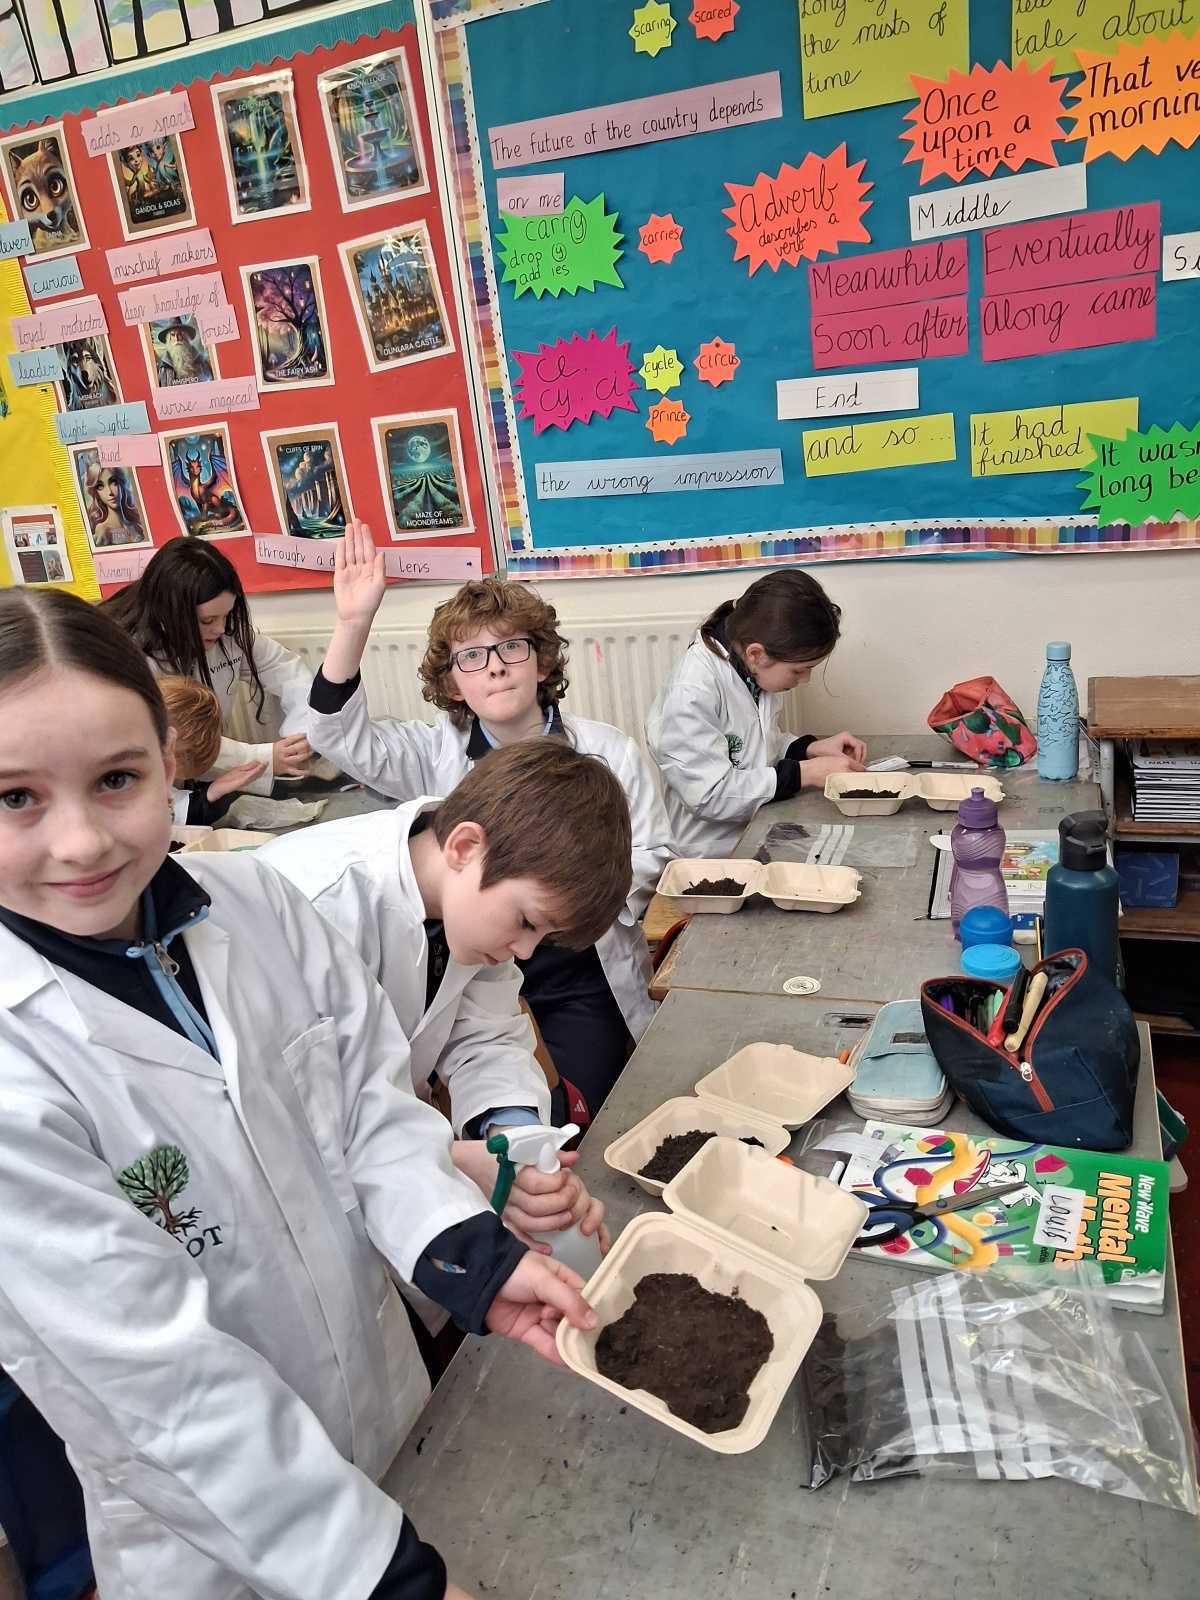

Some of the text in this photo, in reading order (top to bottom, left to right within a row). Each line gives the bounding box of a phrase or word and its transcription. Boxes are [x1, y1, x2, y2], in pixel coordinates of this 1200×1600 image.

[634, 16, 672, 38] scaring
[694, 5, 733, 22] scared
[1015, 18, 1078, 56] tale
[1102, 0, 1195, 40] about
[803, 34, 840, 58] the
[852, 10, 910, 45] mists
[928, 2, 947, 36] of
[806, 69, 862, 95] time
[1087, 55, 1153, 98] That
[923, 87, 1000, 125] Once
[491, 89, 764, 161] The future of the country depends
[922, 113, 1032, 159] upon a
[952, 142, 1018, 173] time
[508, 193, 562, 210] on me
[739, 163, 838, 233] Adverb
[917, 192, 1012, 230] Middle
[524, 211, 586, 242] carry
[642, 228, 679, 246] carries
[758, 212, 840, 248] describes a
[113, 241, 214, 276] mischief makers
[510, 249, 542, 270] drop
[775, 236, 806, 257] verb
[811, 242, 966, 299] Meanwhile
[984, 208, 1156, 275] Eventually
[32, 273, 79, 294] curious
[518, 263, 570, 286] add ies
[814, 285, 1157, 359] Soon after Along came
[644, 353, 674, 379] cycle
[699, 350, 738, 370] circus
[814, 382, 863, 411] End
[651, 408, 688, 428] prince
[972, 404, 1068, 448] It had
[805, 425, 863, 464] and
[976, 426, 1084, 476] finished
[1101, 441, 1121, 468] It
[540, 463, 776, 495] the wrong impression
[1099, 473, 1153, 503] long
[406, 518, 454, 526] MOONDREAMS
[415, 510, 444, 519] MAZE OF
[258, 541, 306, 567] through
[316, 554, 325, 566] a
[398, 556, 431, 574] lens
[1096, 1171, 1137, 1264] Mental
[1134, 1173, 1156, 1233] New Wave
